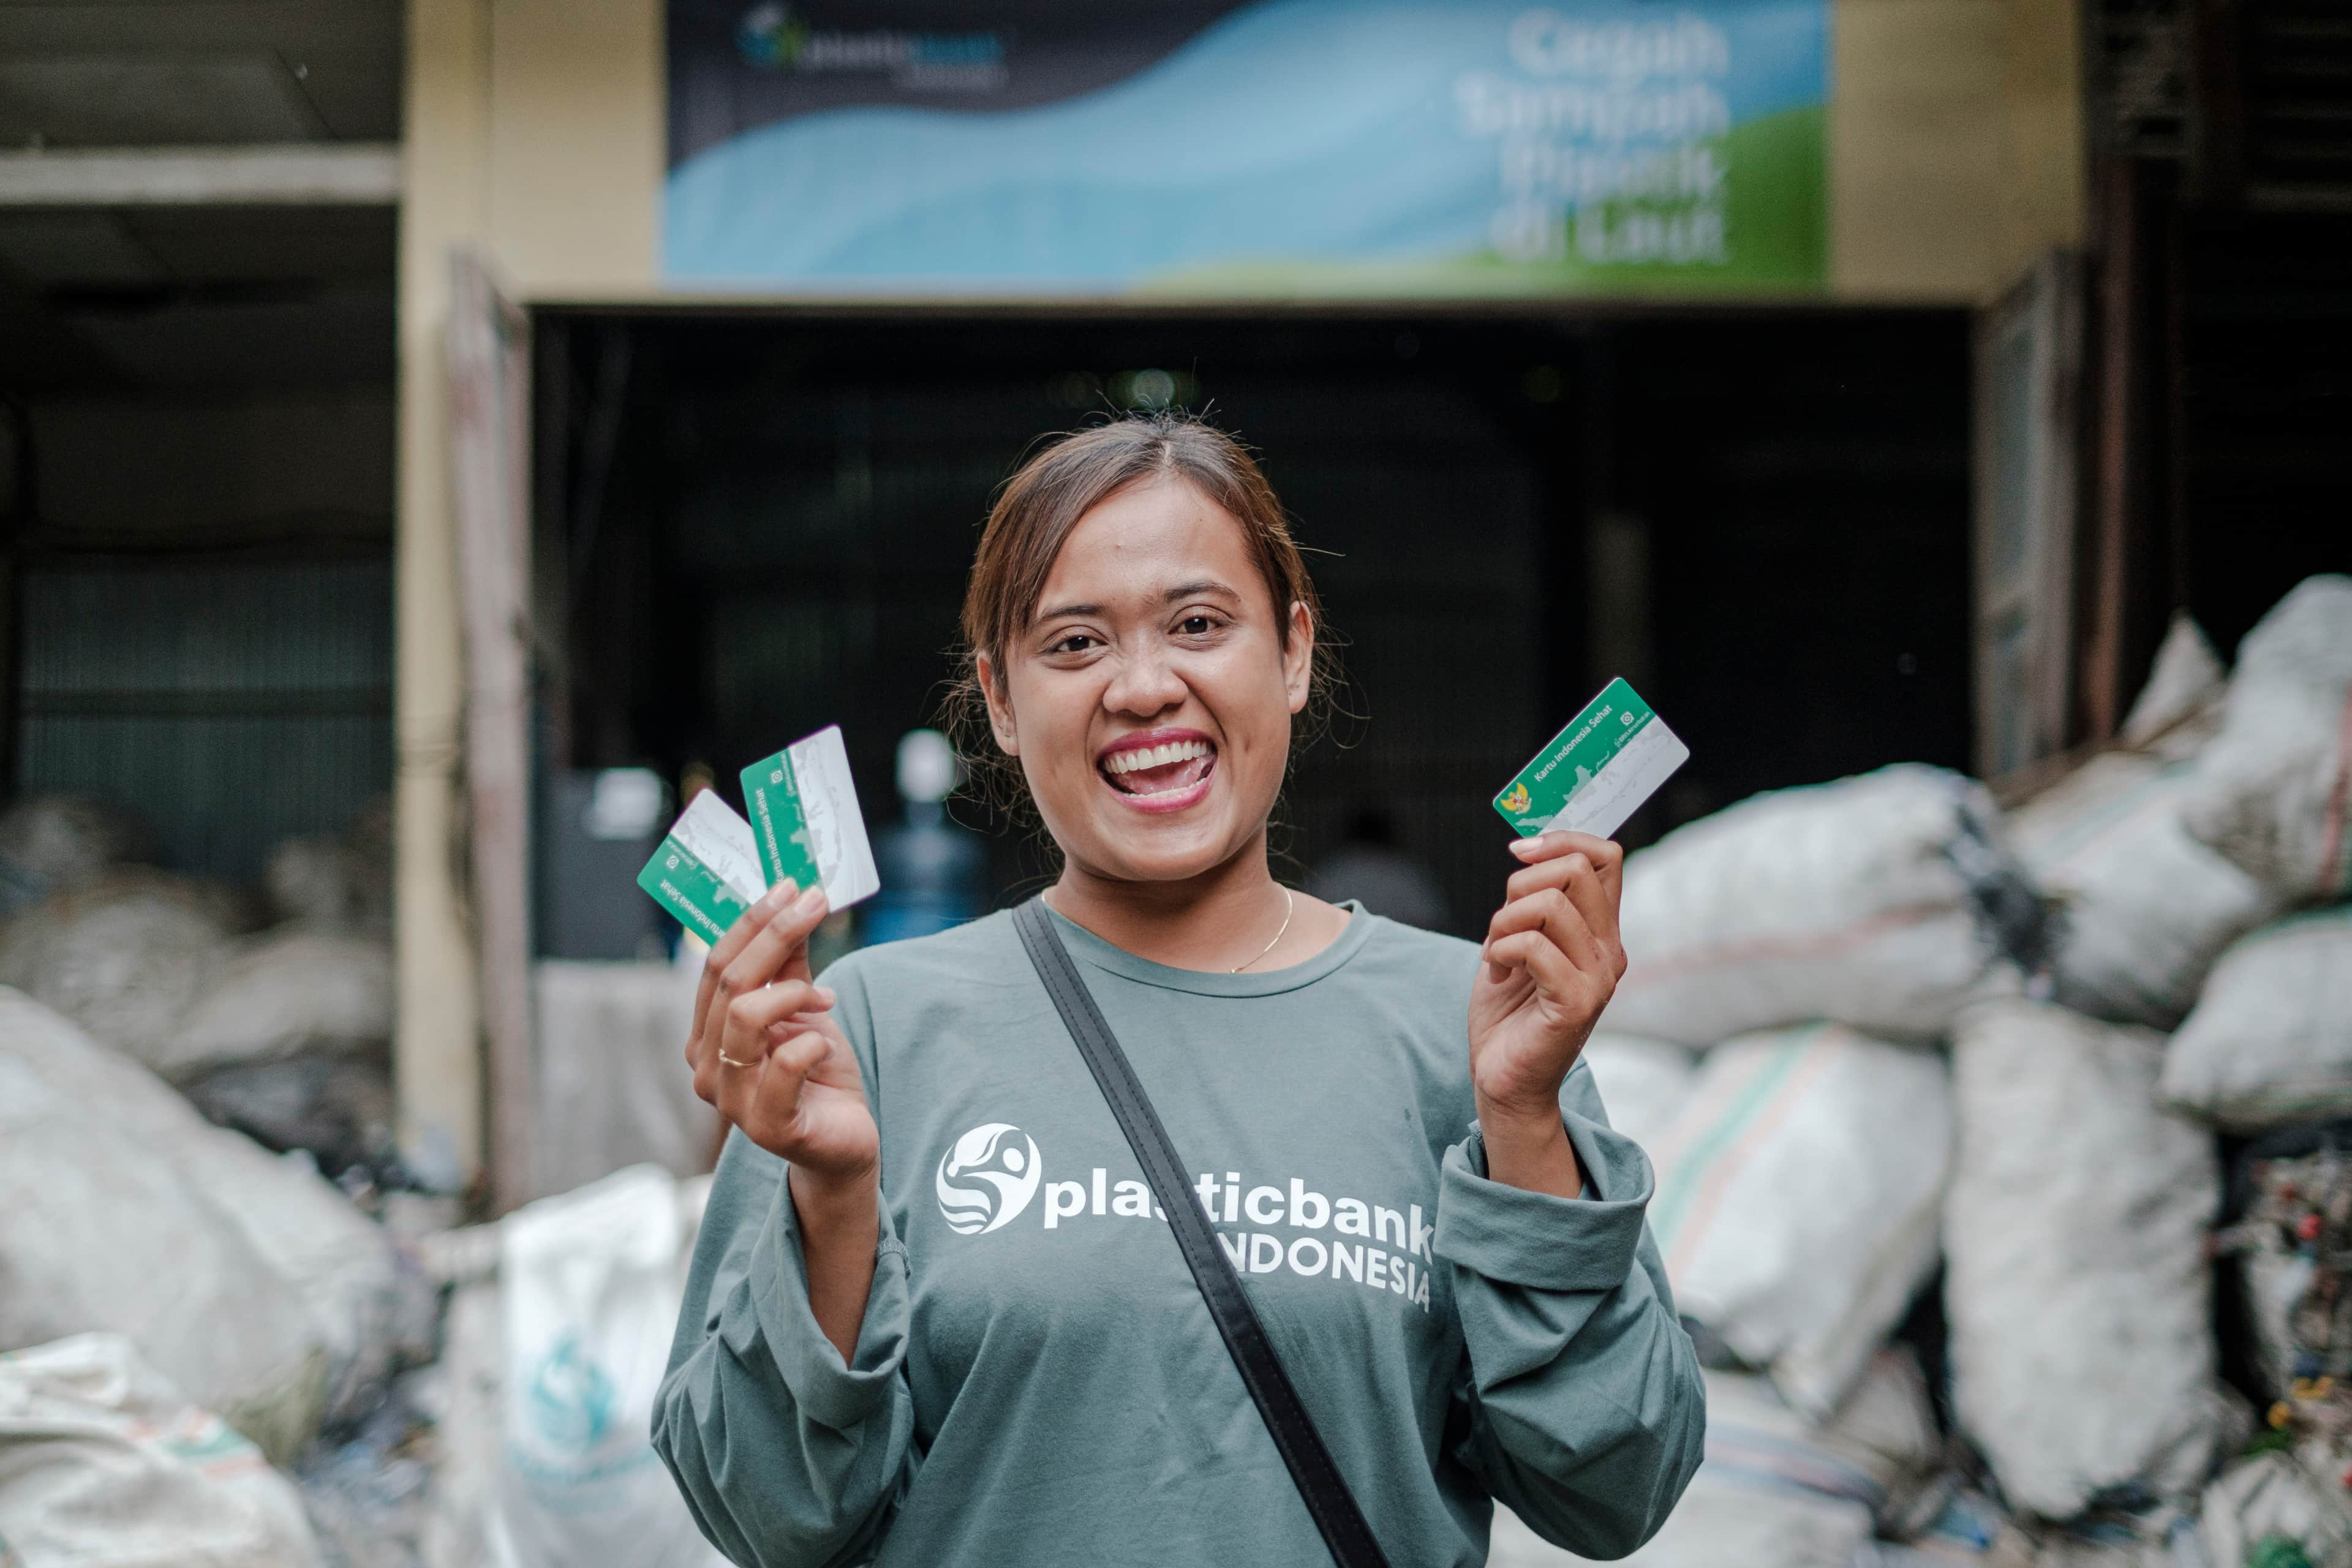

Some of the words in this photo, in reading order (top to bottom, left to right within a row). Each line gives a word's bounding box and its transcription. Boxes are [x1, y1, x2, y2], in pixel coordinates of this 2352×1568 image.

[1534, 760, 1557, 782] Kartu
[1554, 726, 1591, 762] Indonesia
[1588, 704, 1612, 728] Sehat
[756, 788, 768, 815] Sehat
[761, 815, 779, 860] Indonesia
[660, 878, 681, 901] Sehat
[679, 895, 712, 929] Indonesia
[710, 923, 726, 938] artu
[1044, 1167, 1434, 1265] platicbank
[1216, 1232, 1430, 1314] NDONESIA
